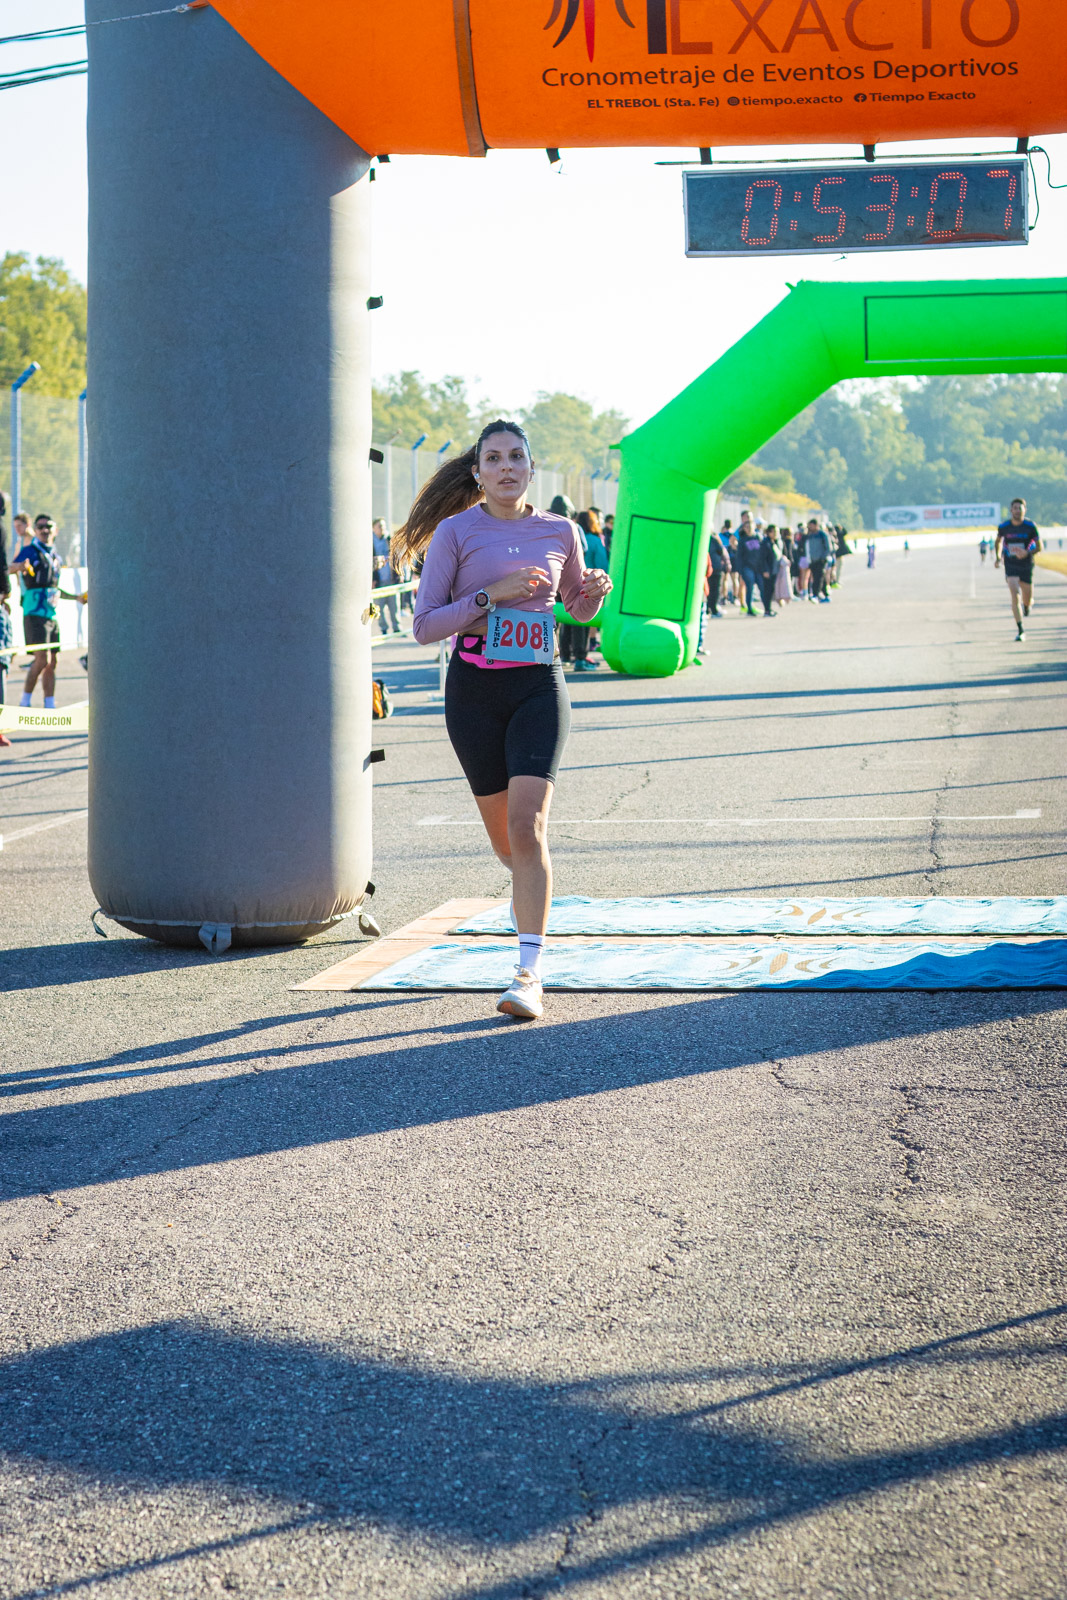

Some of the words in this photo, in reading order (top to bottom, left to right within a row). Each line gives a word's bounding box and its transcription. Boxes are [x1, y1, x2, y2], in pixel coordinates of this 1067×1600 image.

[541, 65, 715, 88] Cronometraje
[722, 63, 754, 83] de
[763, 62, 865, 82] Eventos
[873, 58, 1019, 82] Deportivos
[587, 99, 603, 108] EL
[605, 98, 661, 108] TREBOL
[664, 97, 696, 108] (Sta.
[699, 97, 720, 108] Fe)
[742, 94, 843, 107] tiempo.exacto
[869, 92, 925, 103] Tiempo
[928, 90, 976, 101] Exacto
[500, 619, 543, 650] 208
[18, 716, 72, 725] PRECAUCION
